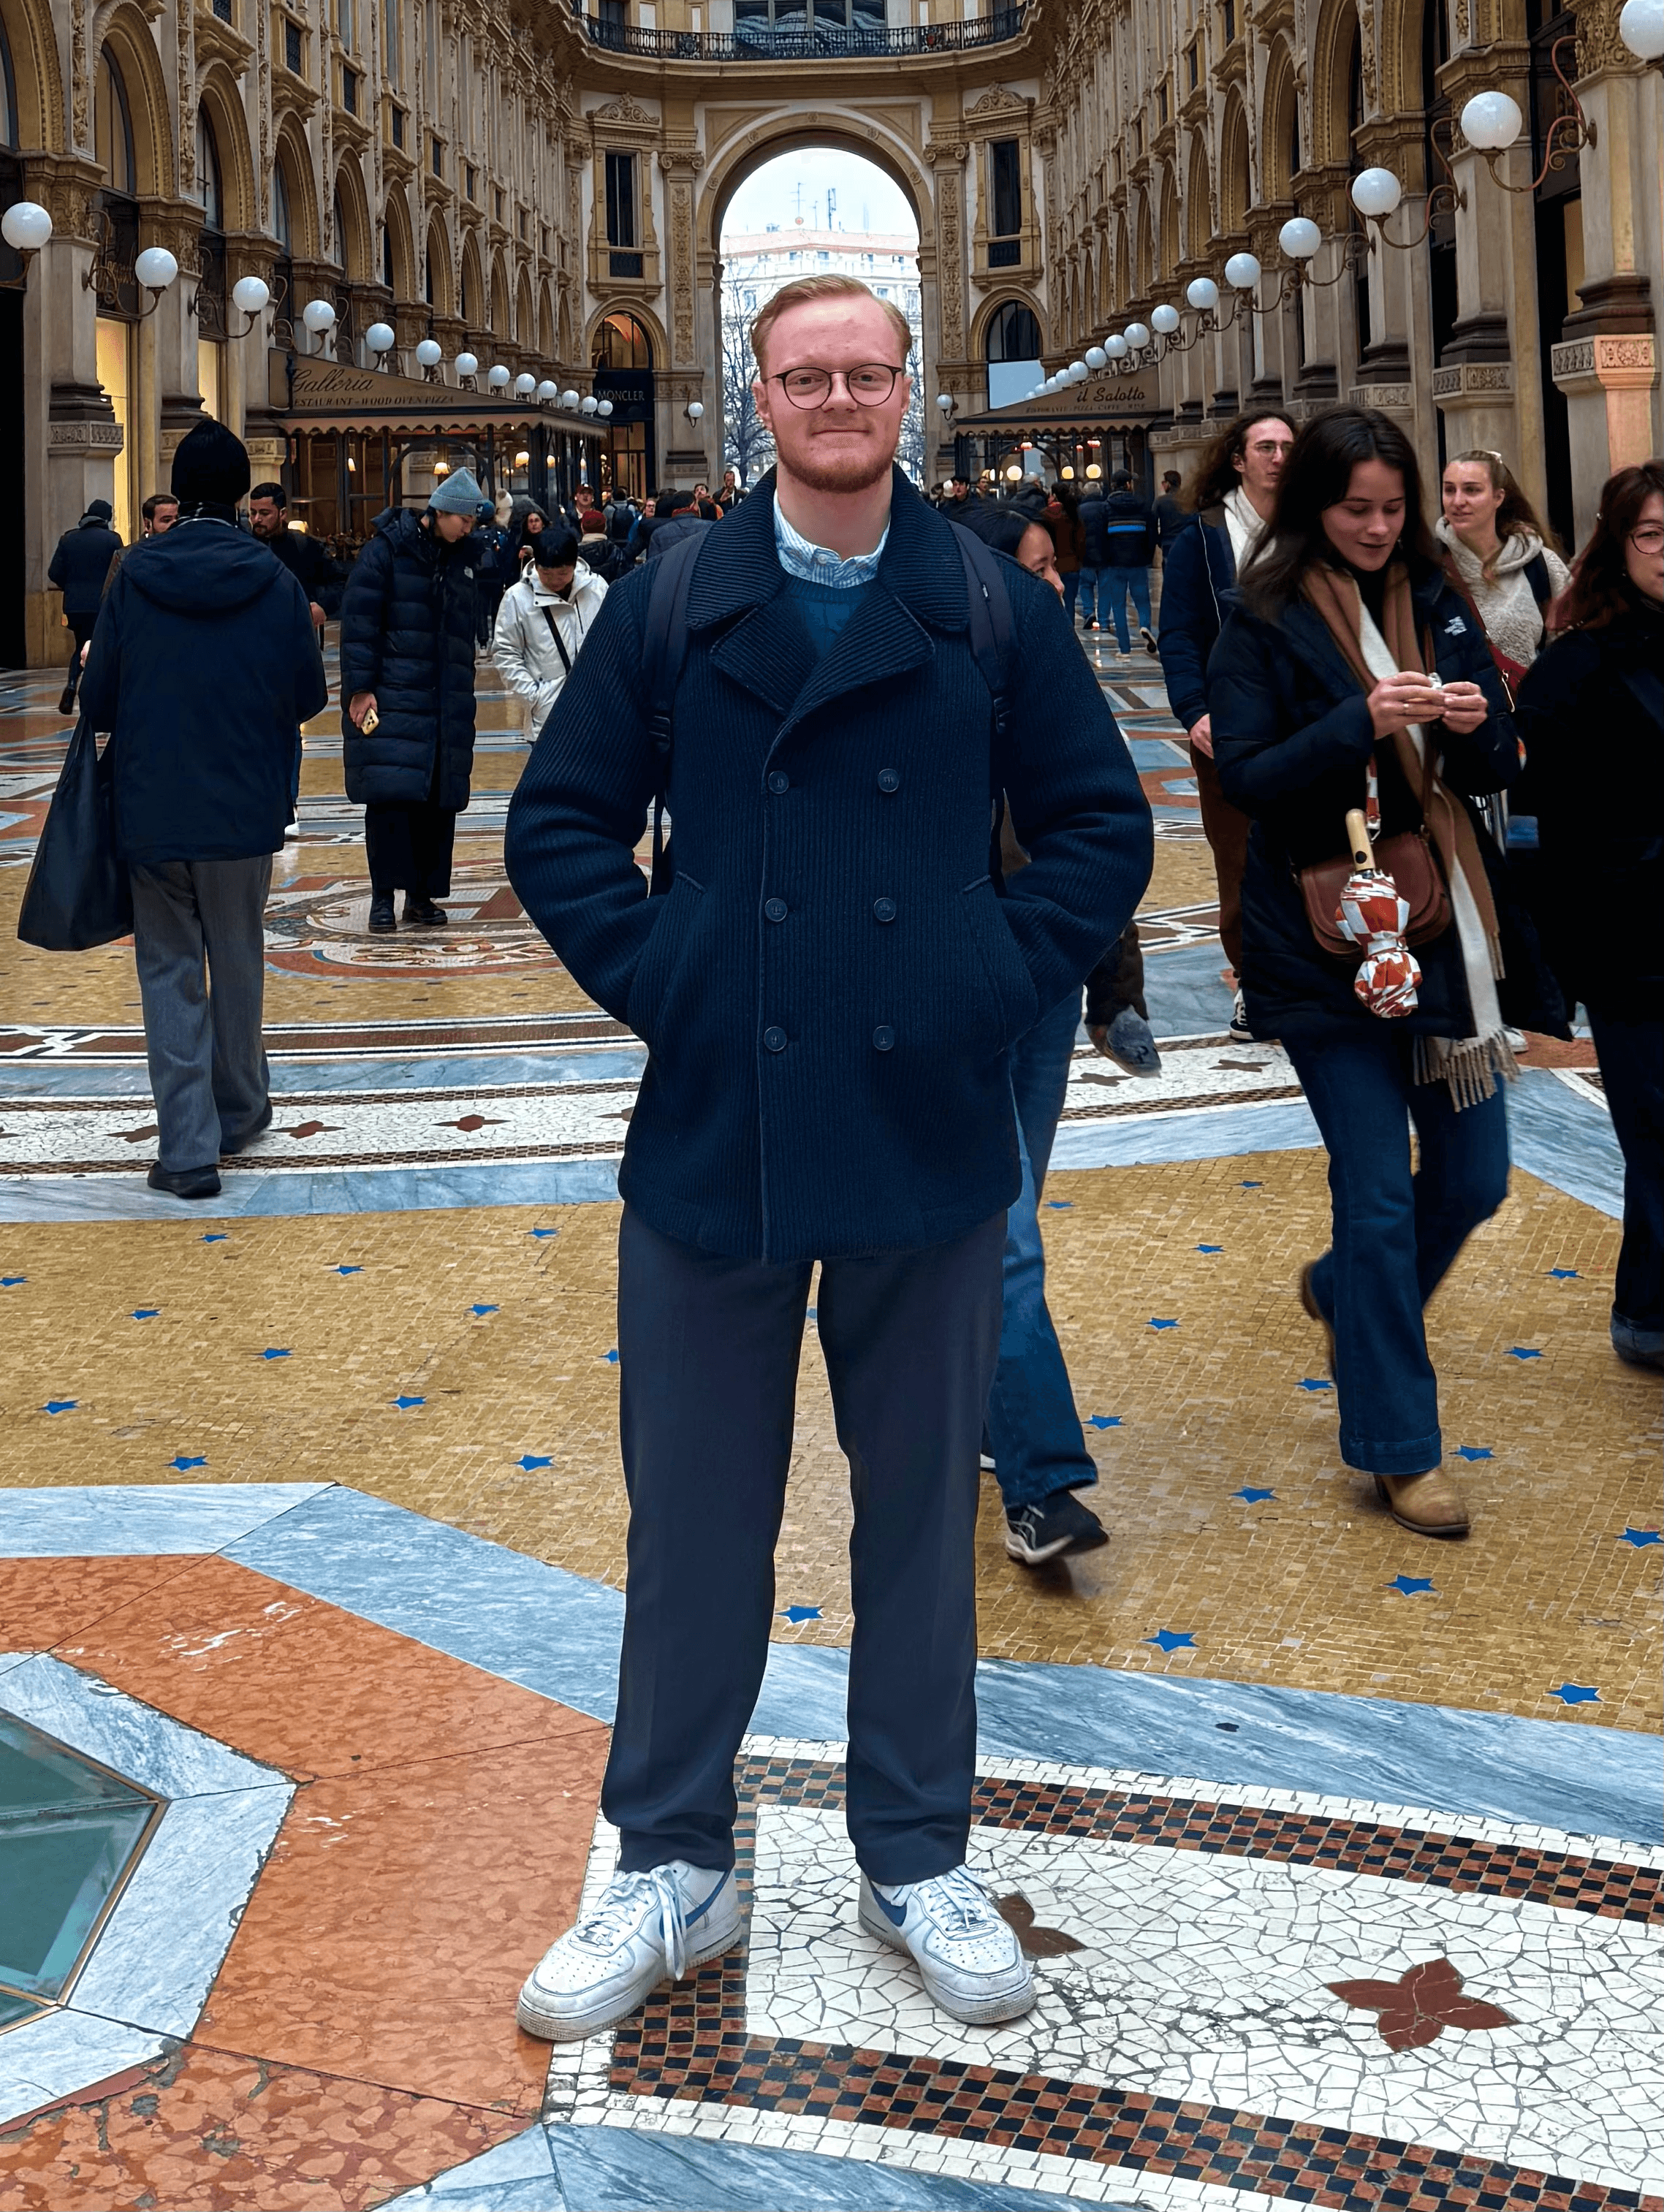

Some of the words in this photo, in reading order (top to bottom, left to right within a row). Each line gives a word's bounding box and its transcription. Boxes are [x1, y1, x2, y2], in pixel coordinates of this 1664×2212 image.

[292, 368, 373, 392] Galleria
[293, 397, 354, 407] ESTAURANT
[425, 395, 454, 404] PIZZA
[597, 389, 645, 401] MONCLER
[1076, 386, 1089, 403] il
[1093, 385, 1146, 402] Salotto
